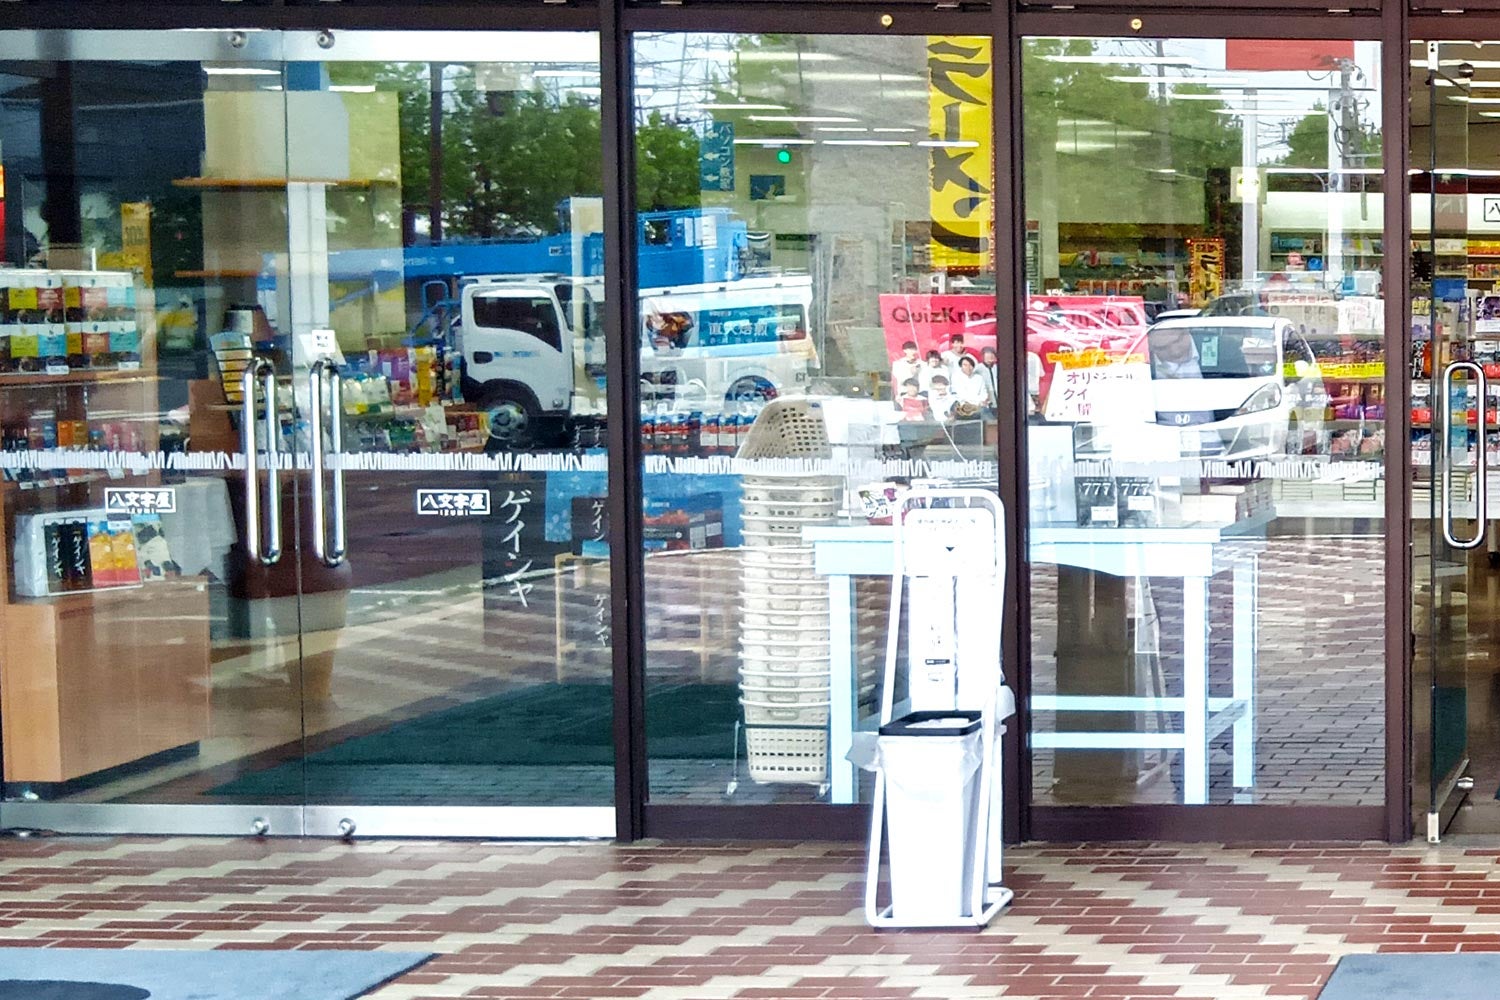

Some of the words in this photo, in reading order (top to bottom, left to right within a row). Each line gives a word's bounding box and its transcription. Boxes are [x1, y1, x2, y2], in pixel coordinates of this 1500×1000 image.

[892, 305, 997, 324] QuizKnoc
[109, 491, 172, 508] 八文字屋
[422, 493, 486, 510] 八文字屋
